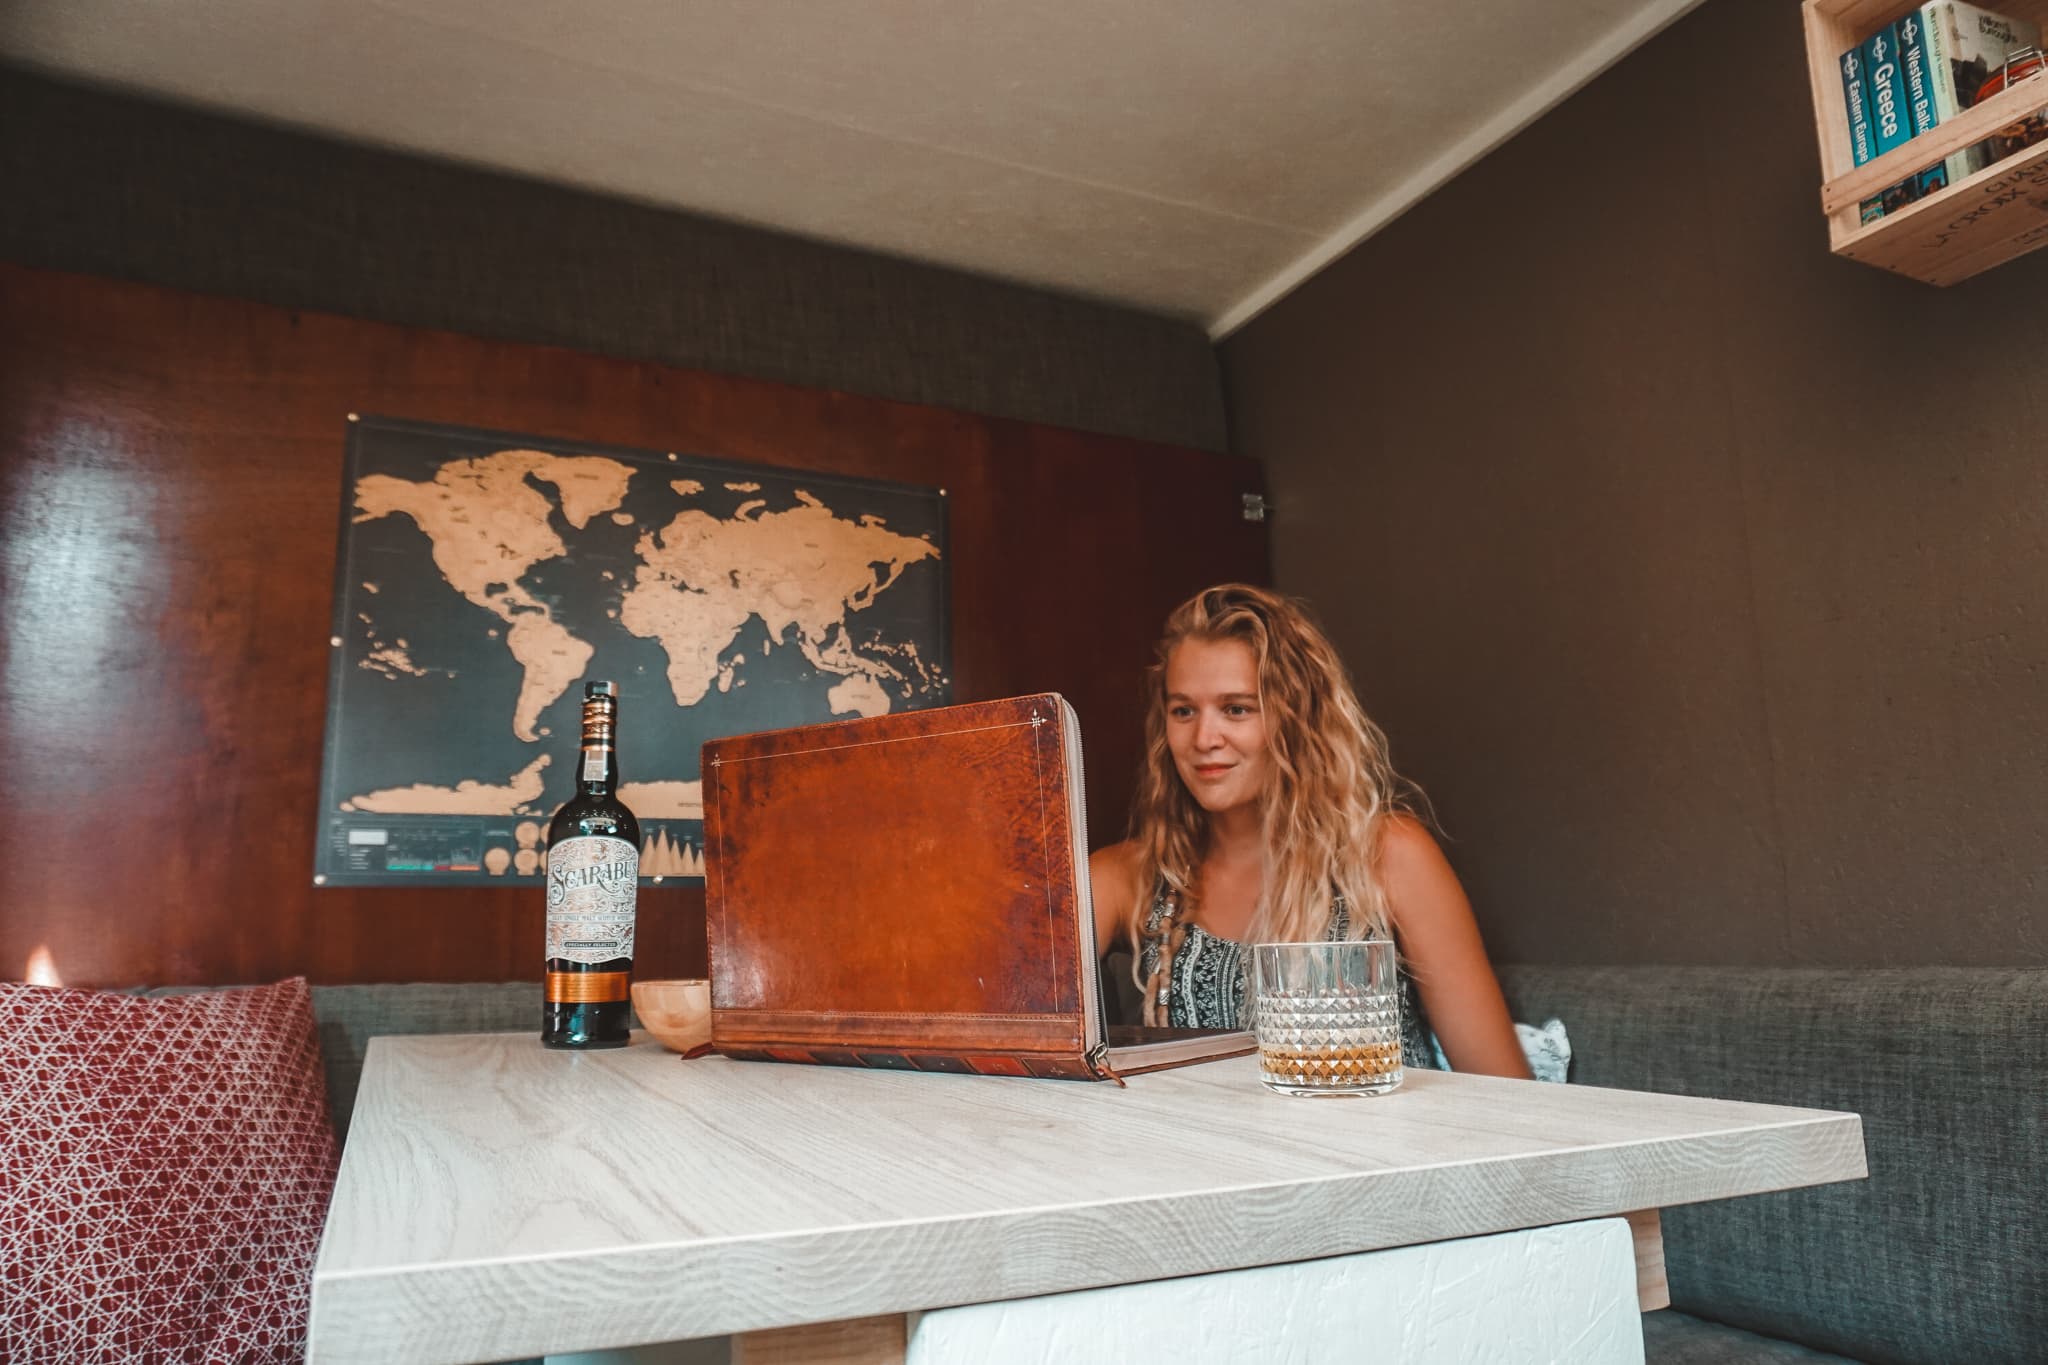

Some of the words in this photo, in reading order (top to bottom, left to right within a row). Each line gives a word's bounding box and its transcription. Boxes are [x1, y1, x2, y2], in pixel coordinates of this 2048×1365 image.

[1907, 45, 1924, 100] Western
[1849, 80, 1863, 124] Eastern
[1874, 63, 1897, 138] Greece
[1855, 122, 1868, 162] Europe
